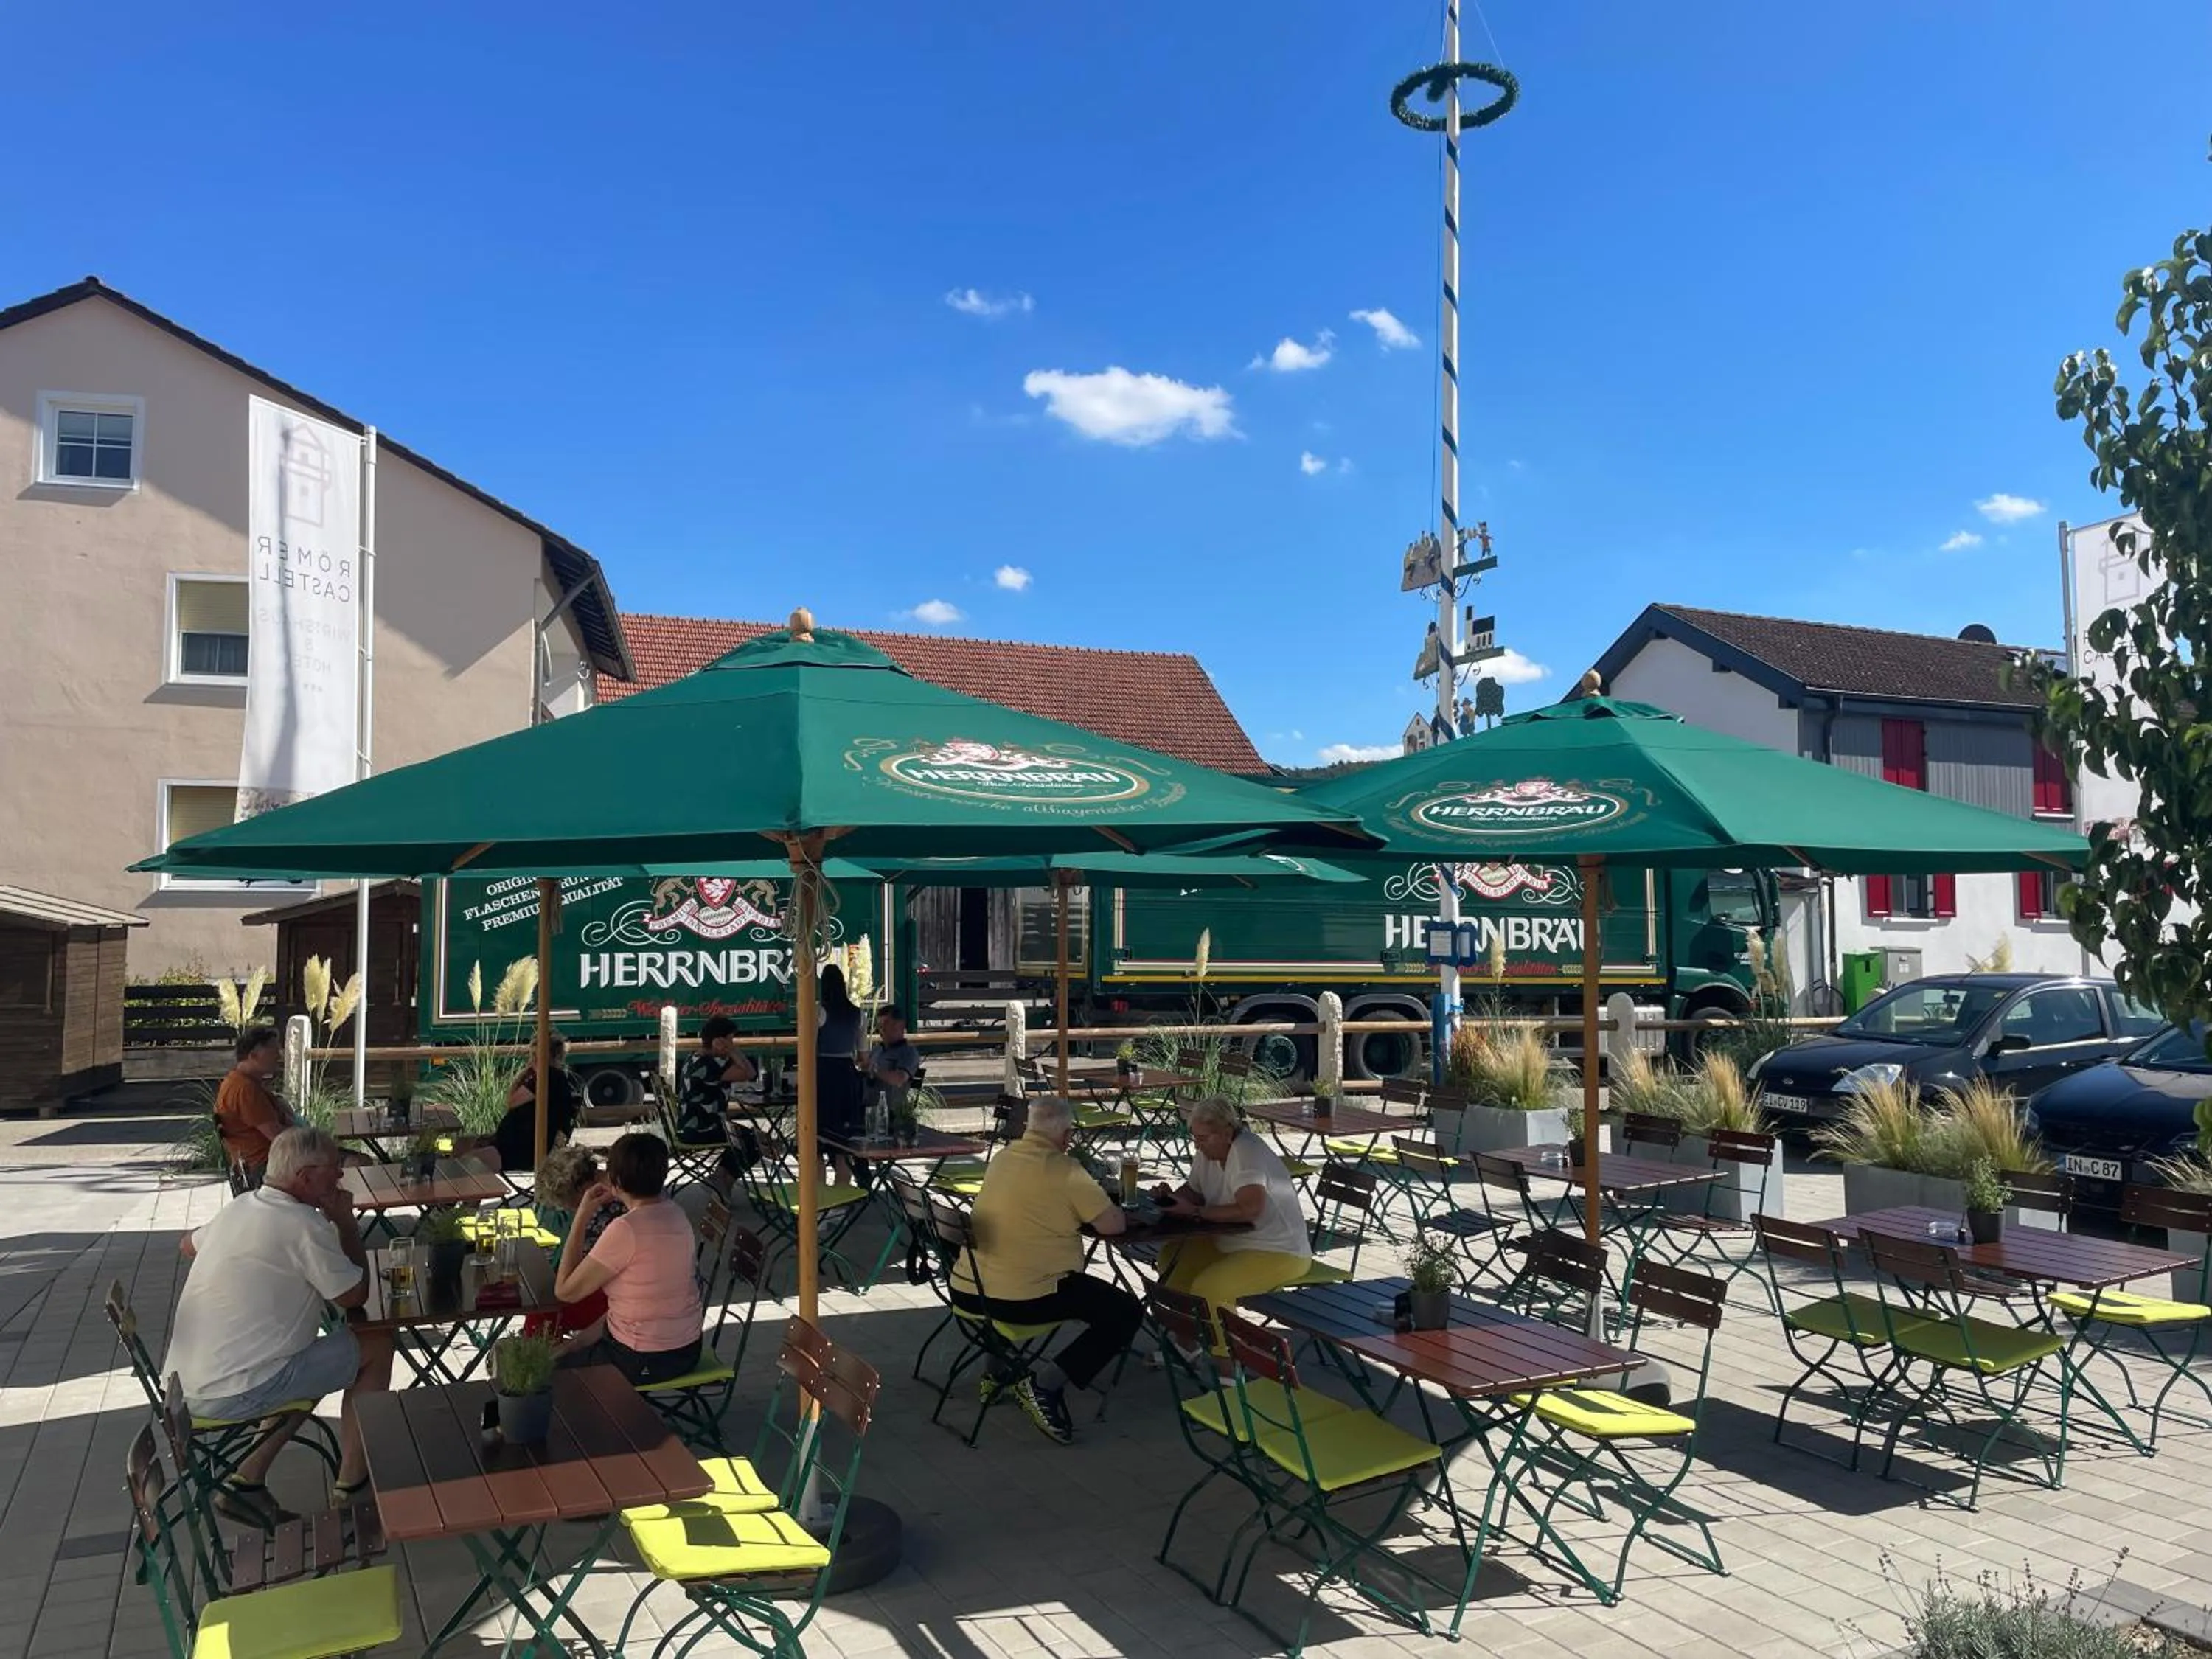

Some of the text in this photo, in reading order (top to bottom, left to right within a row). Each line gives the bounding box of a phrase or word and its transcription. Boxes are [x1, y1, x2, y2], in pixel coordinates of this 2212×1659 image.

[1429, 804, 1606, 817] HERRNBRÄU
[481, 902, 540, 931] PREMIU
[1385, 914, 1601, 953] HENBRÄ
[2067, 1157, 2118, 1178] IN C 87
